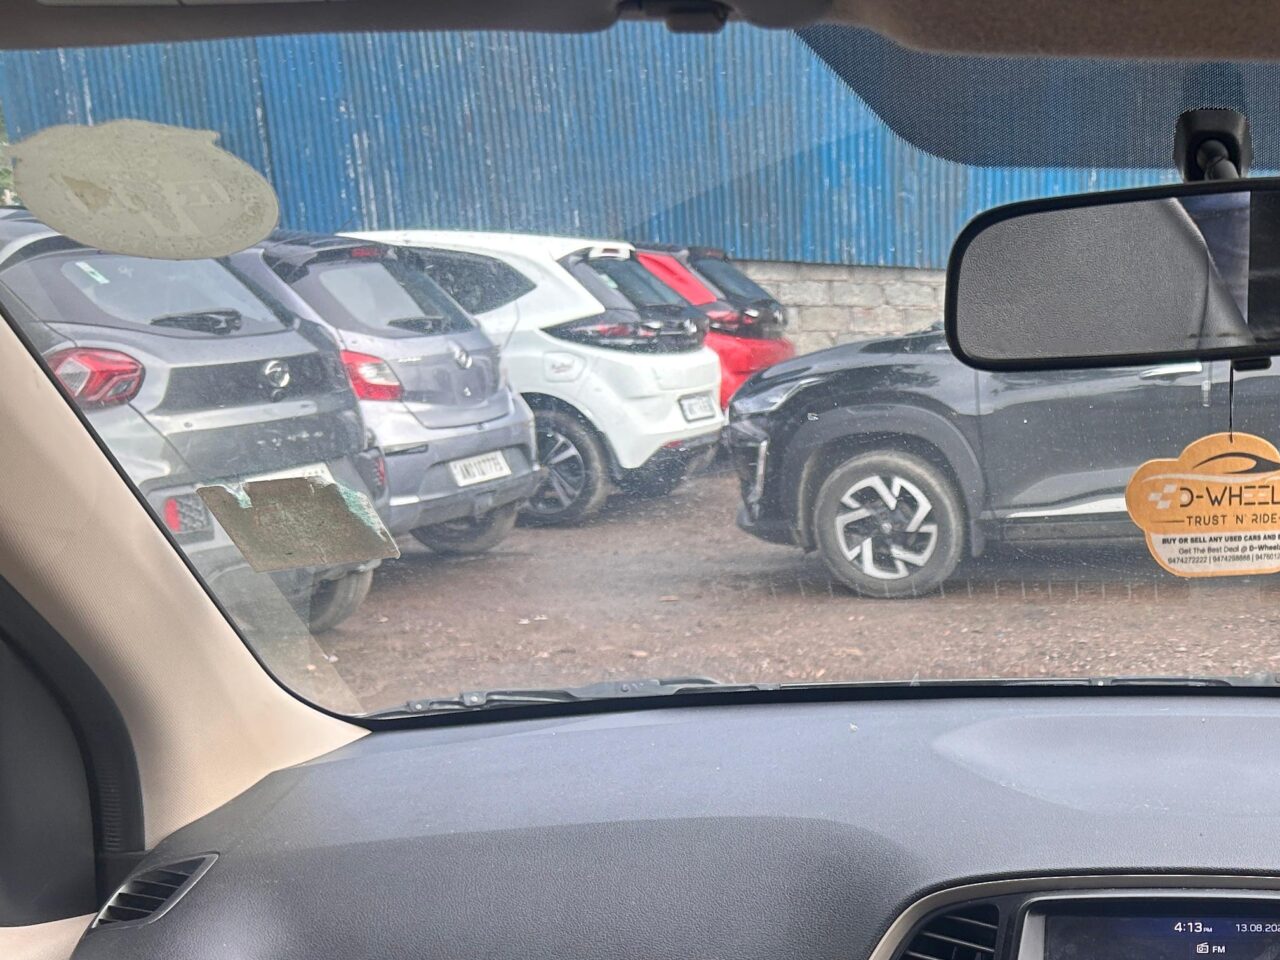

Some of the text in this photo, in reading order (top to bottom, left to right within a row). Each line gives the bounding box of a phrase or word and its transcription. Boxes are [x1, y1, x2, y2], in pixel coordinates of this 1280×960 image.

[1186, 514, 1227, 526] TRUST
[1252, 513, 1278, 524] RIDE
[1174, 922, 1202, 933] 4:13
